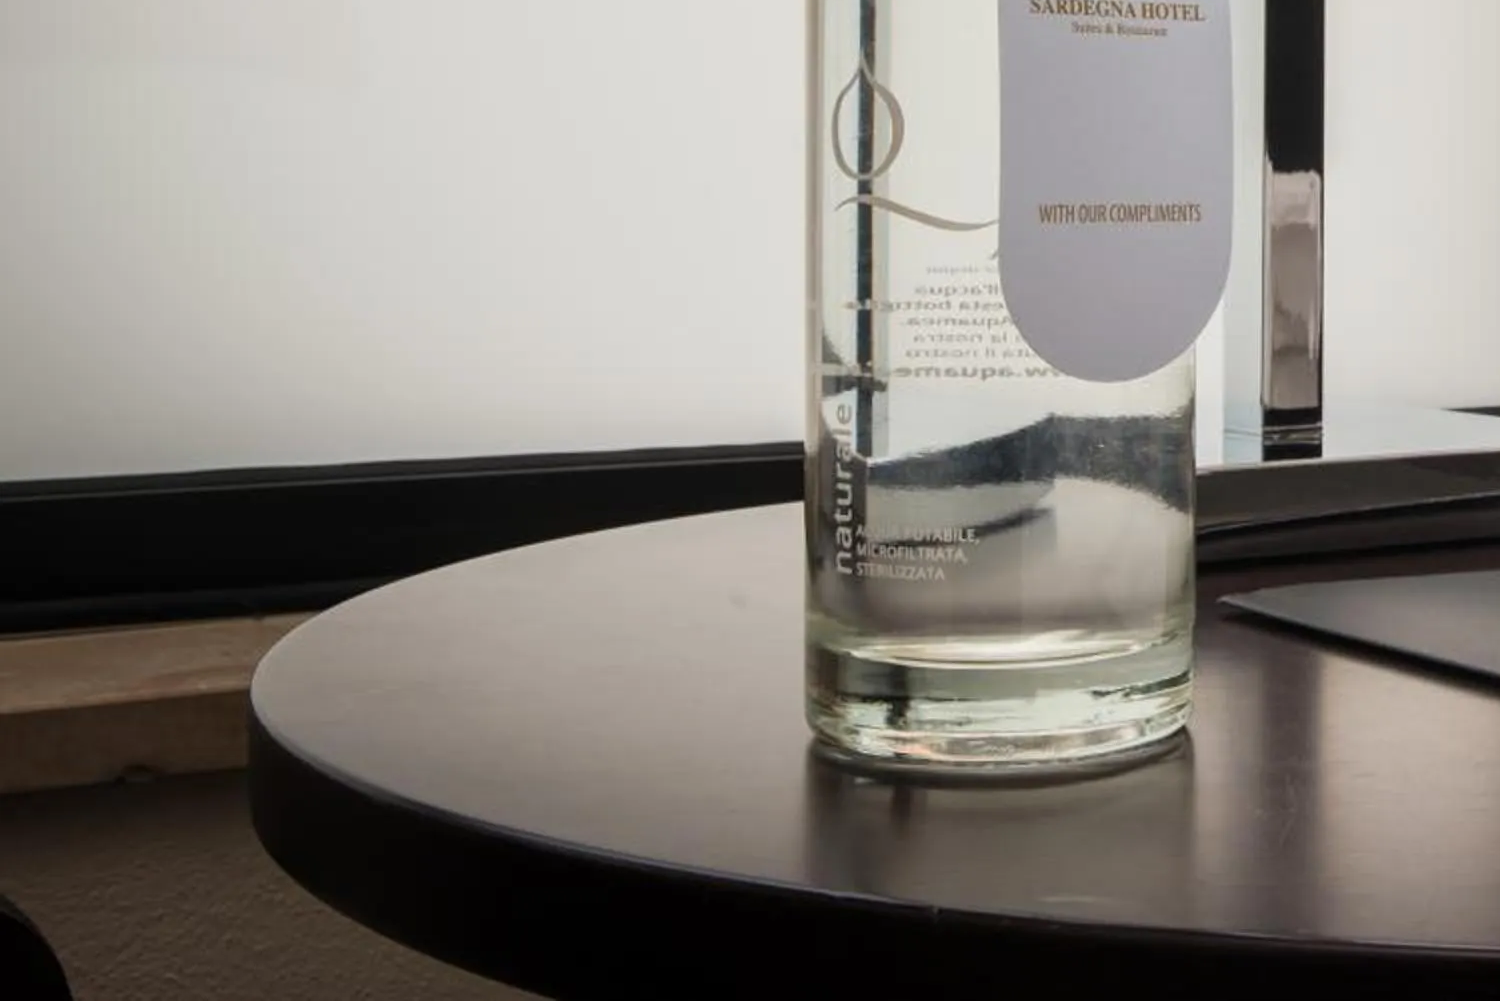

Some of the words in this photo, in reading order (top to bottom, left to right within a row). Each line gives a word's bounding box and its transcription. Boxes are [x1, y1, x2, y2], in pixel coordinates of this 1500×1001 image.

[1141, 2, 1206, 22] HOTEL
[1038, 203, 1075, 224] WITH
[1077, 204, 1107, 224] OUR
[1109, 203, 1202, 223] COMPLIMENTS
[831, 403, 853, 575] naturale
